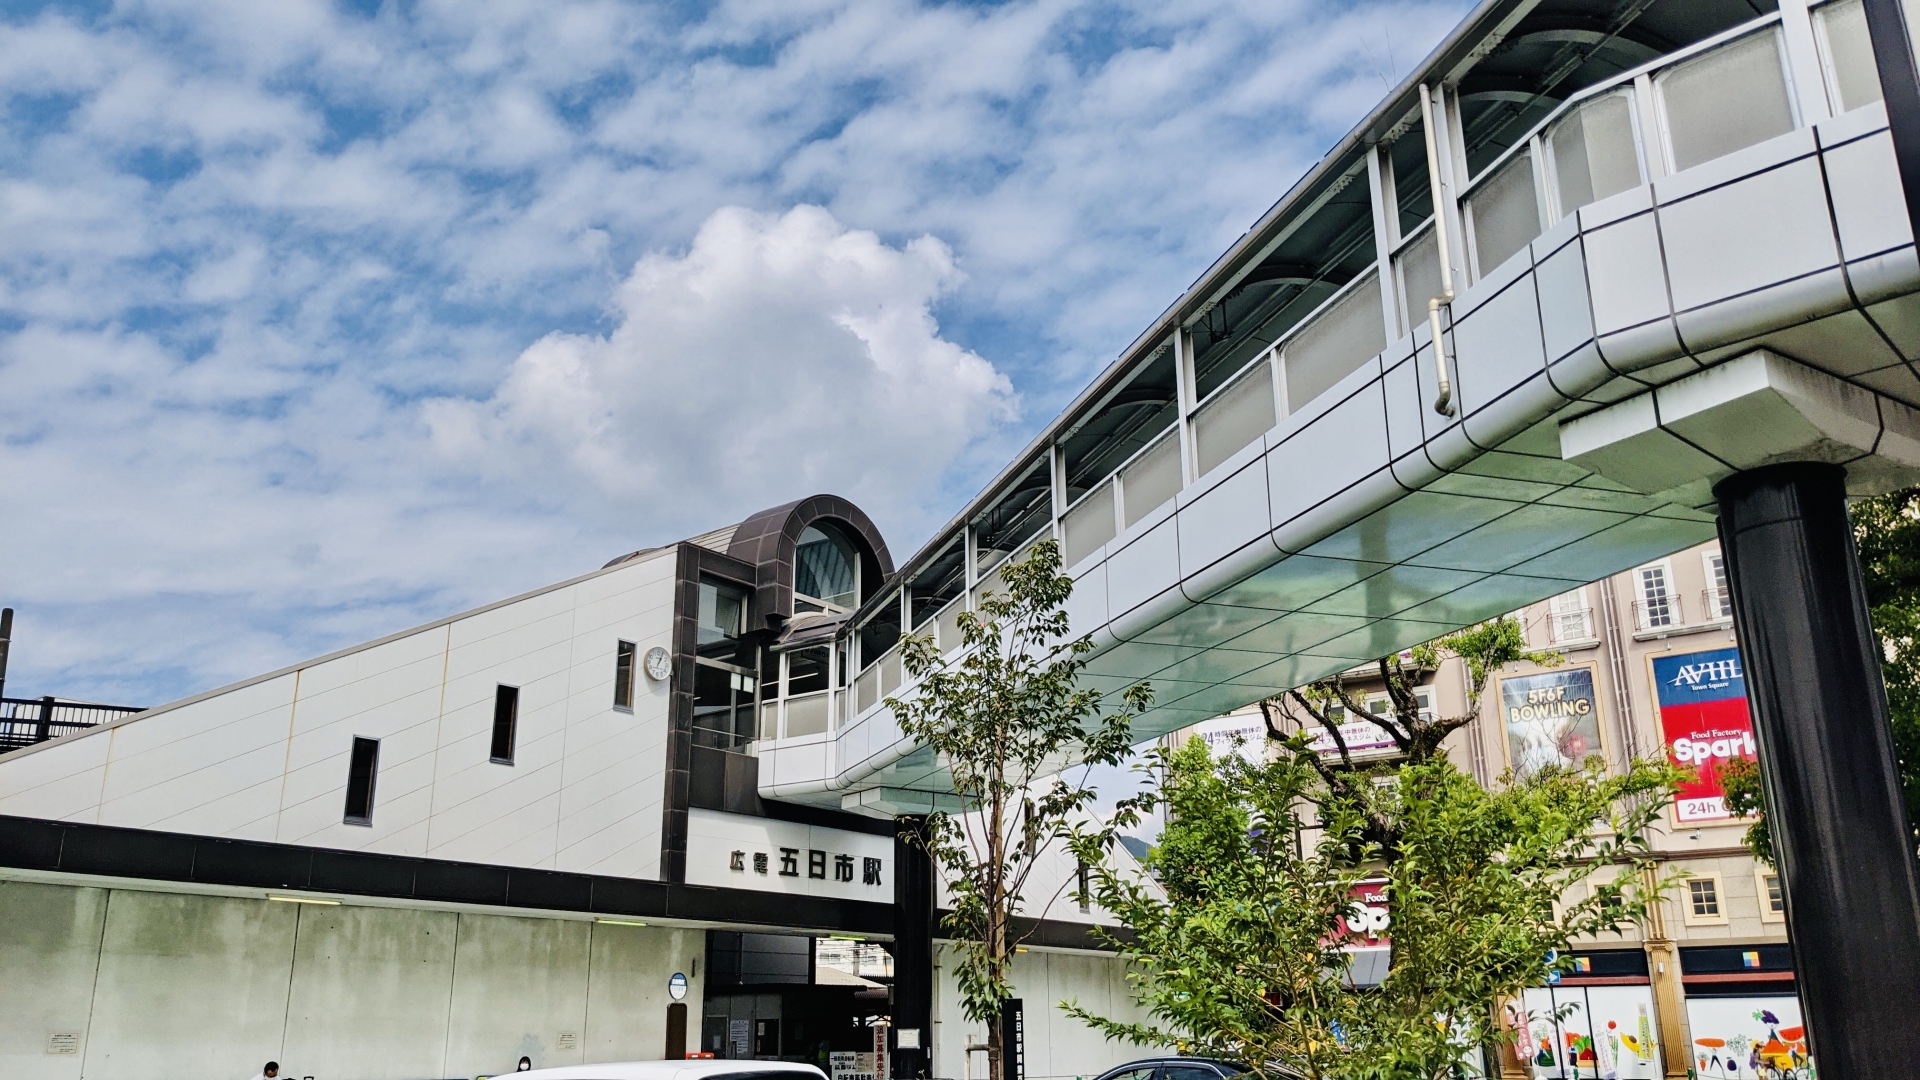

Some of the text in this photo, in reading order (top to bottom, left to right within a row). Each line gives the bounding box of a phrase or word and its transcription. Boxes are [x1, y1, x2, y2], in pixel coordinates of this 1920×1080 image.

[1708, 682, 1729, 690] Square
[1527, 687, 1565, 704] 5F6F
[1510, 698, 1590, 723] BOWLING
[1325, 726, 1371, 738] 時年中無休の
[1691, 729, 1742, 740] Food Factory
[1687, 802, 1716, 815] 24h
